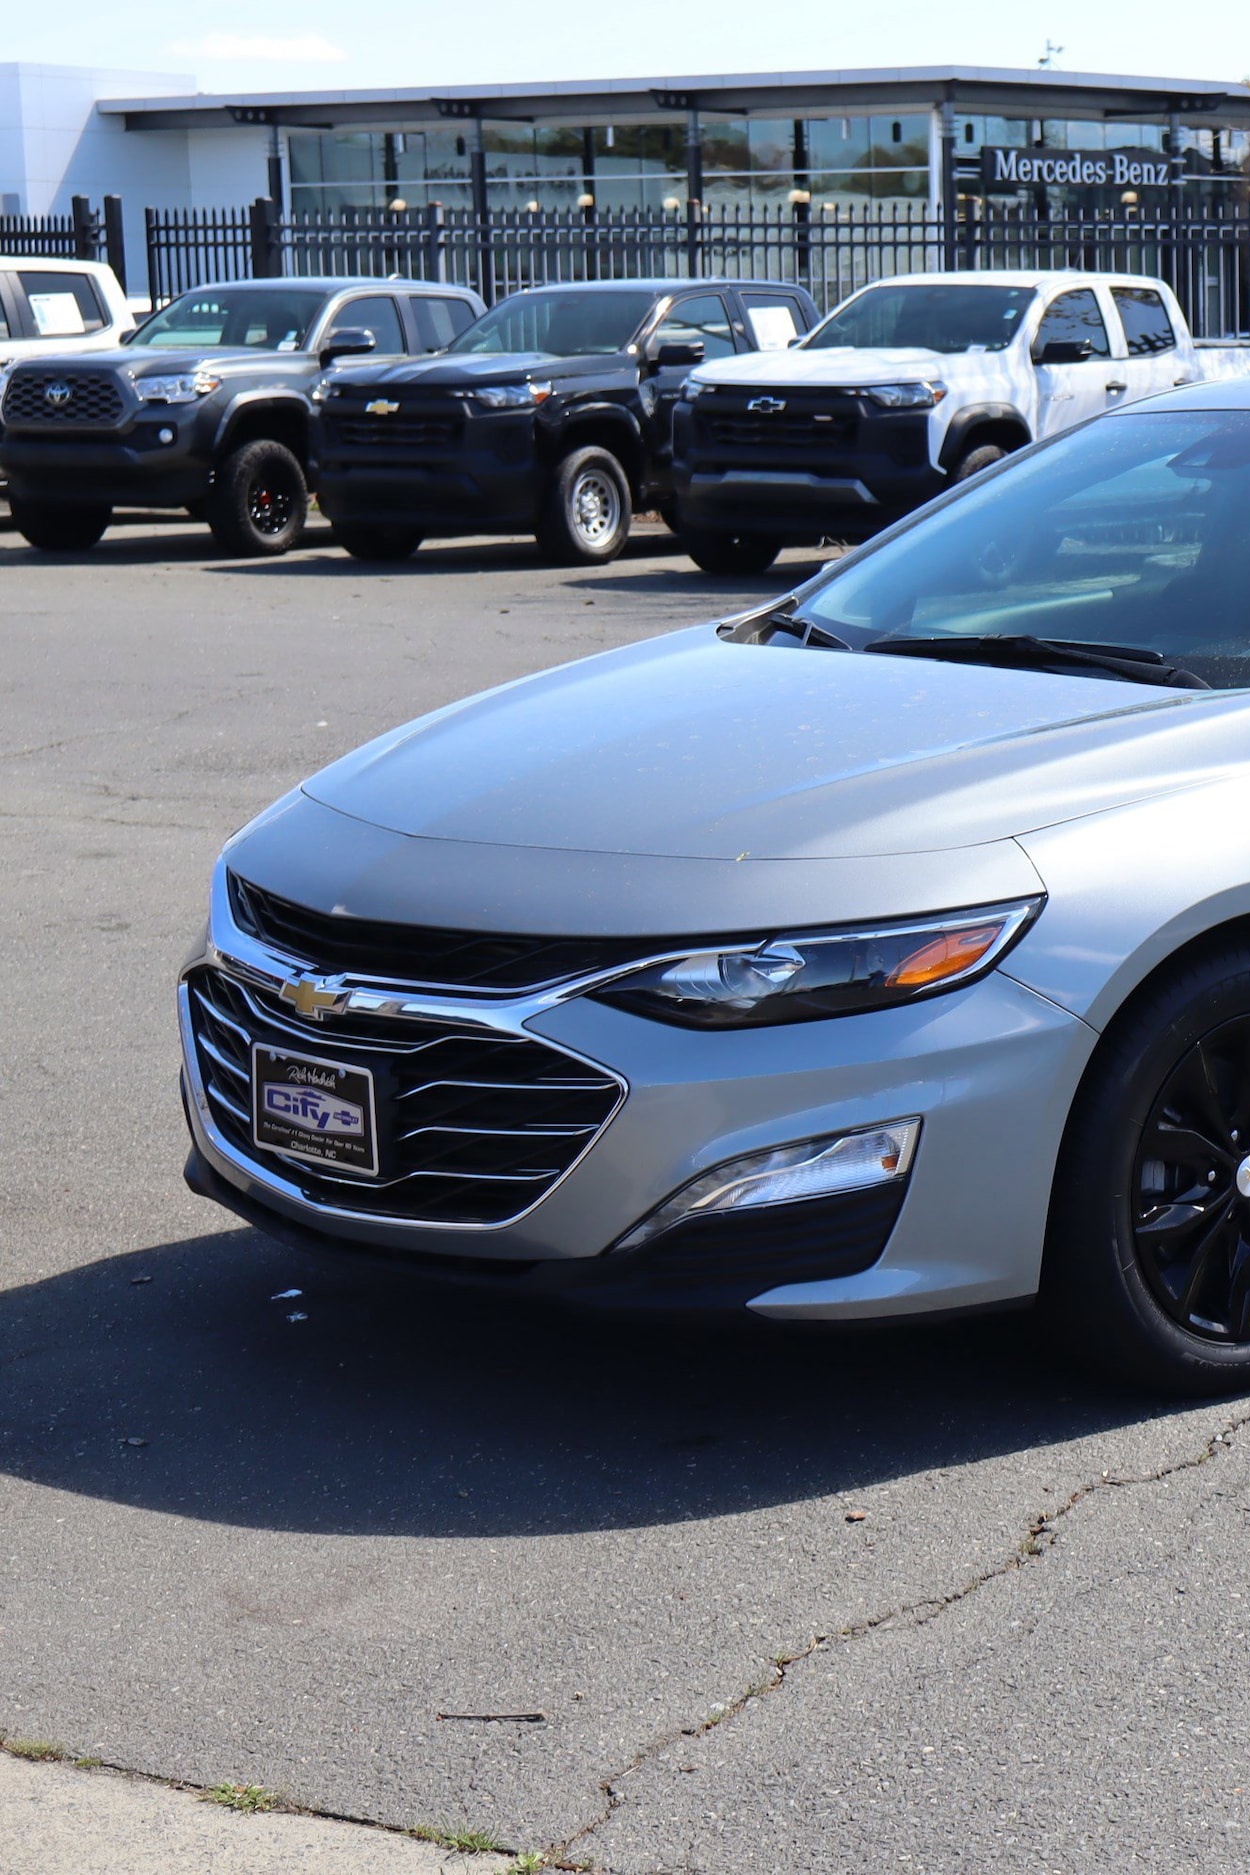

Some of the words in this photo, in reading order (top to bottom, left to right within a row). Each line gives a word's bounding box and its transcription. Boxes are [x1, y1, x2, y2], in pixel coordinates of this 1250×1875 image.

[995, 149, 1169, 186] Mercedes-Benz
[267, 1089, 330, 1128] City
[291, 1142, 323, 1157] Charlotte,
[326, 1149, 336, 1158] NC
